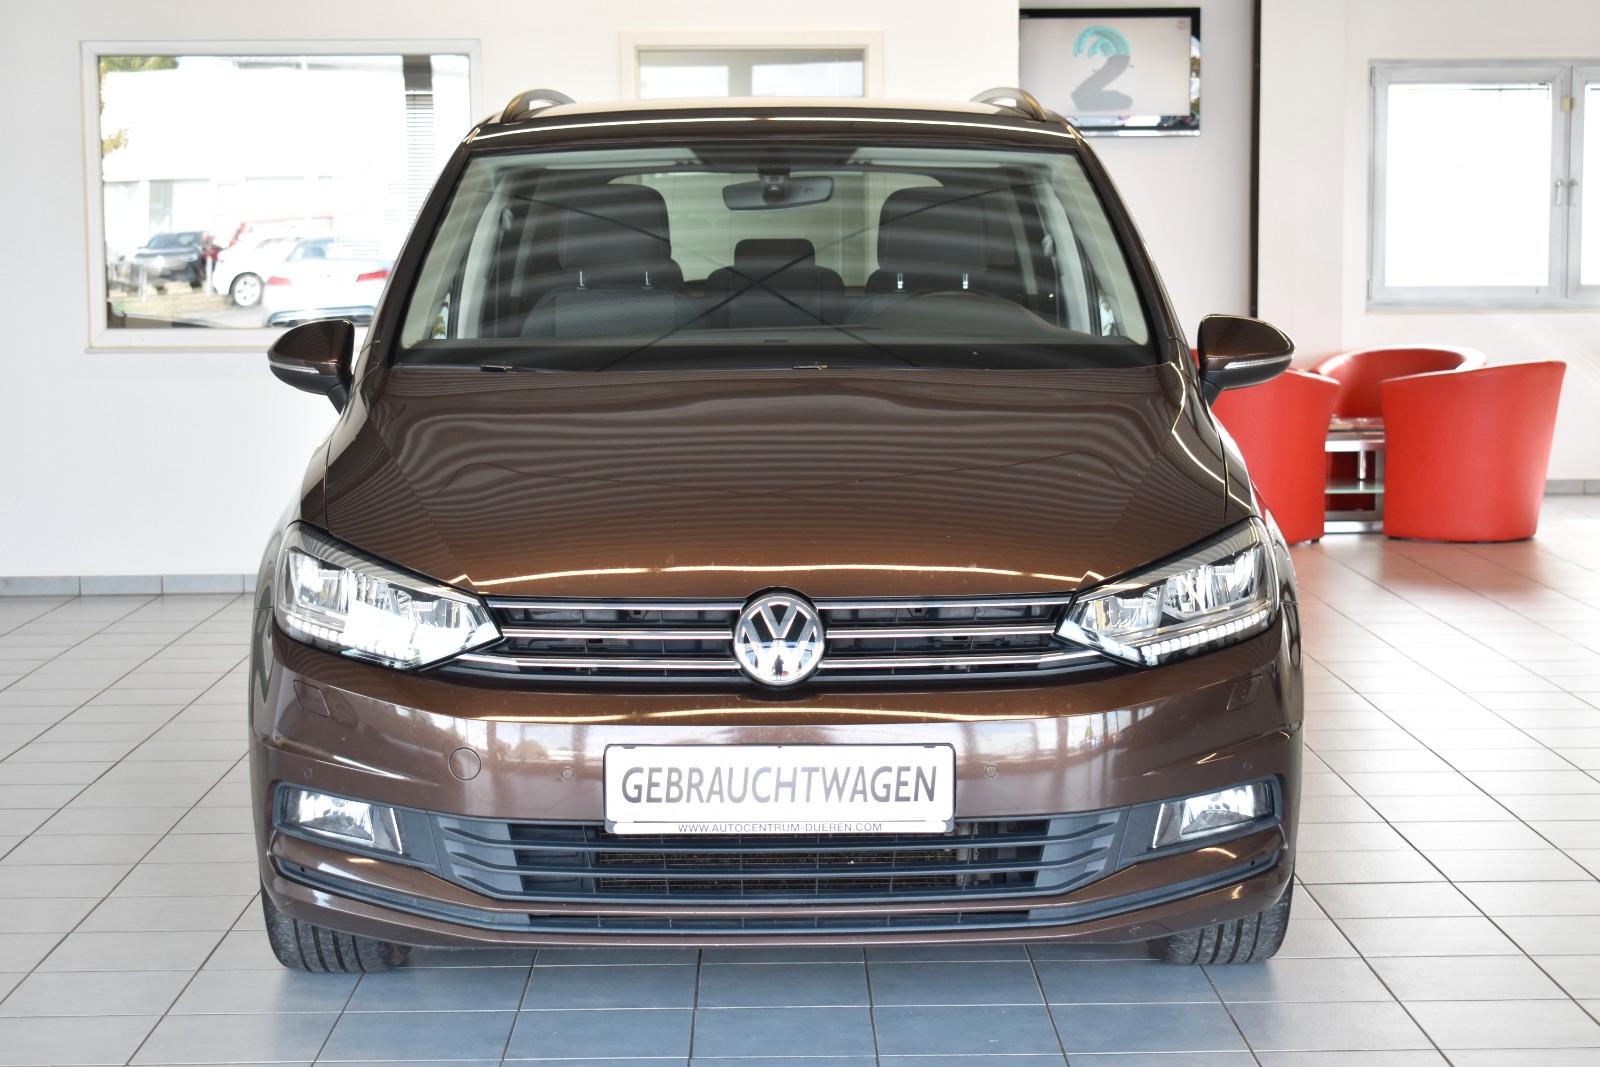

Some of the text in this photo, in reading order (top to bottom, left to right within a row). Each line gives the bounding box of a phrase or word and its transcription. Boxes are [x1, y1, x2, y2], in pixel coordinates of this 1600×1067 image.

[1071, 25, 1133, 112] 2
[621, 766, 937, 803] GEBRAUCHTWAGEN
[678, 822, 882, 833] WWW.AUTOCENTRUM-DUEREN.COM
